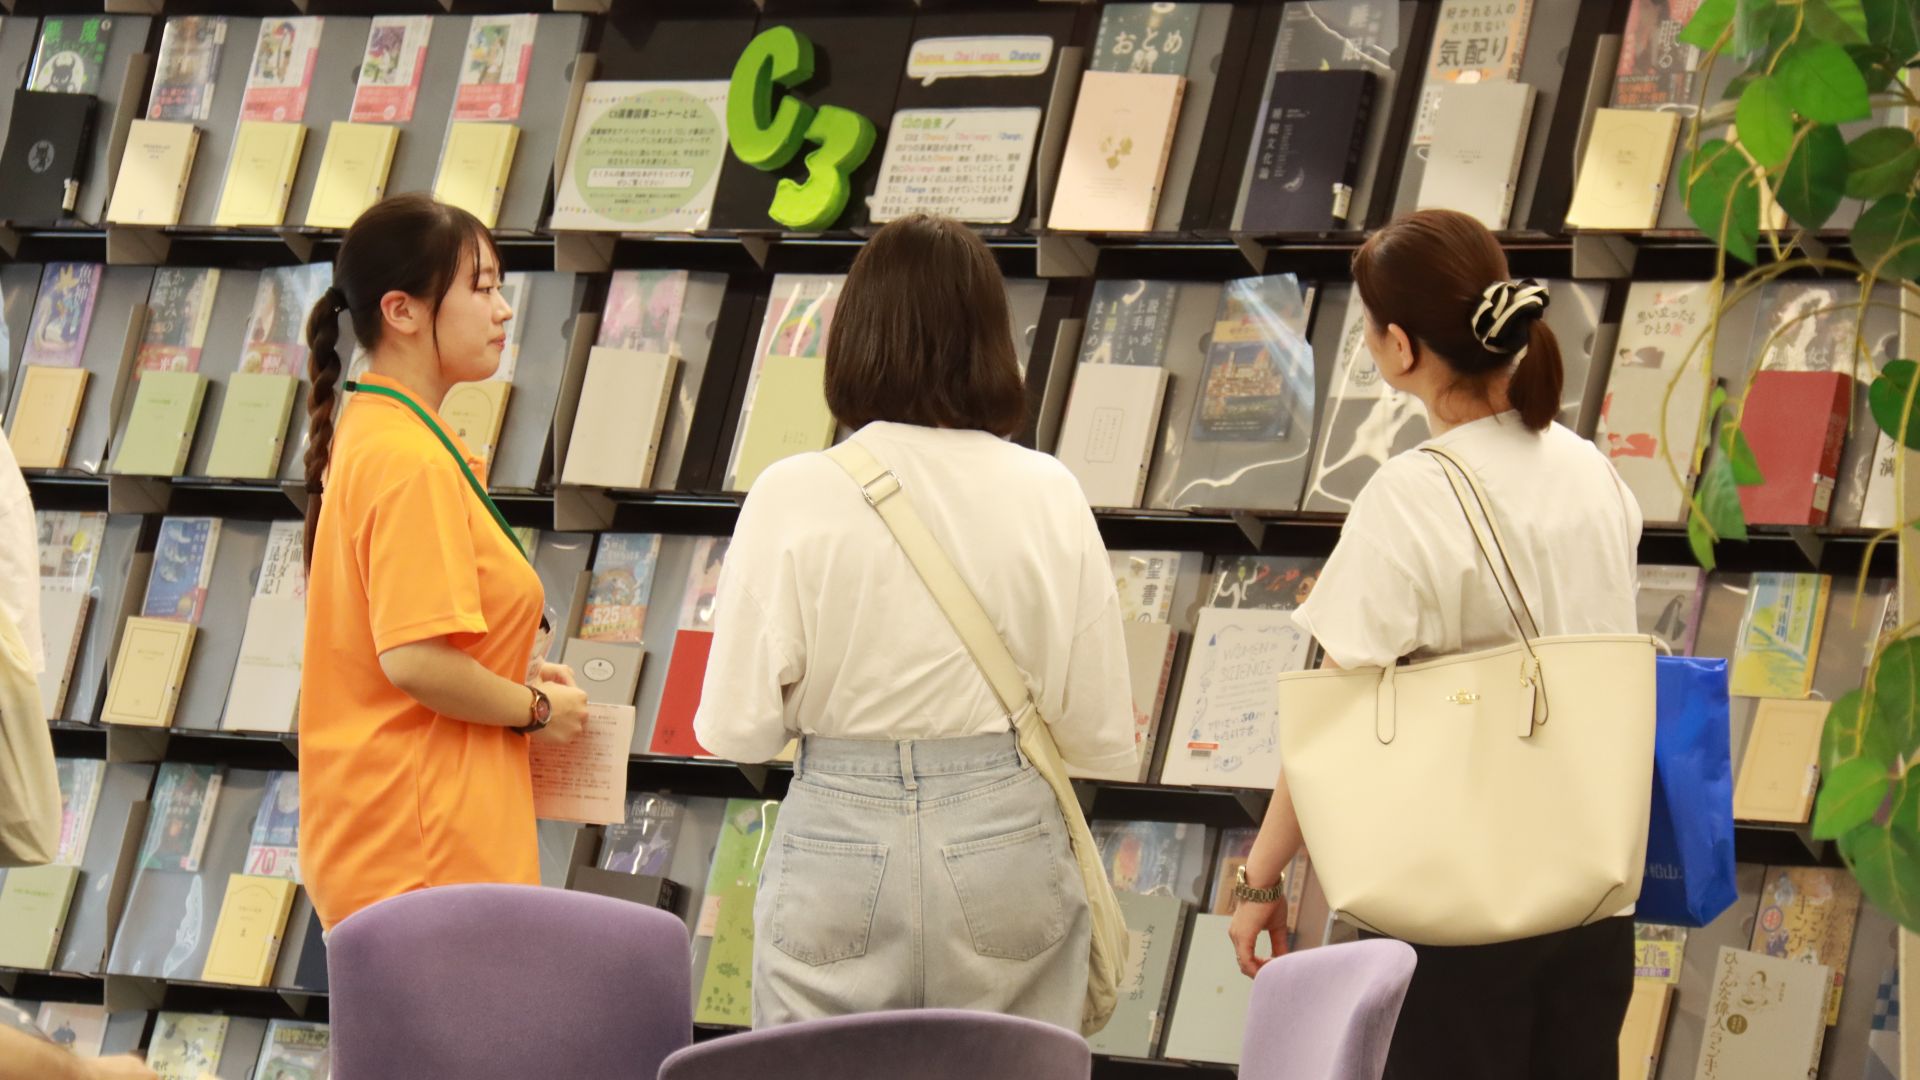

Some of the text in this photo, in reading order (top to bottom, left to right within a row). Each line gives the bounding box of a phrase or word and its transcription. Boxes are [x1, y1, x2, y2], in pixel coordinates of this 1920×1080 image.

[1446, 4, 1516, 19] 好かれる人の
[1437, 36, 1508, 67] 気配り
